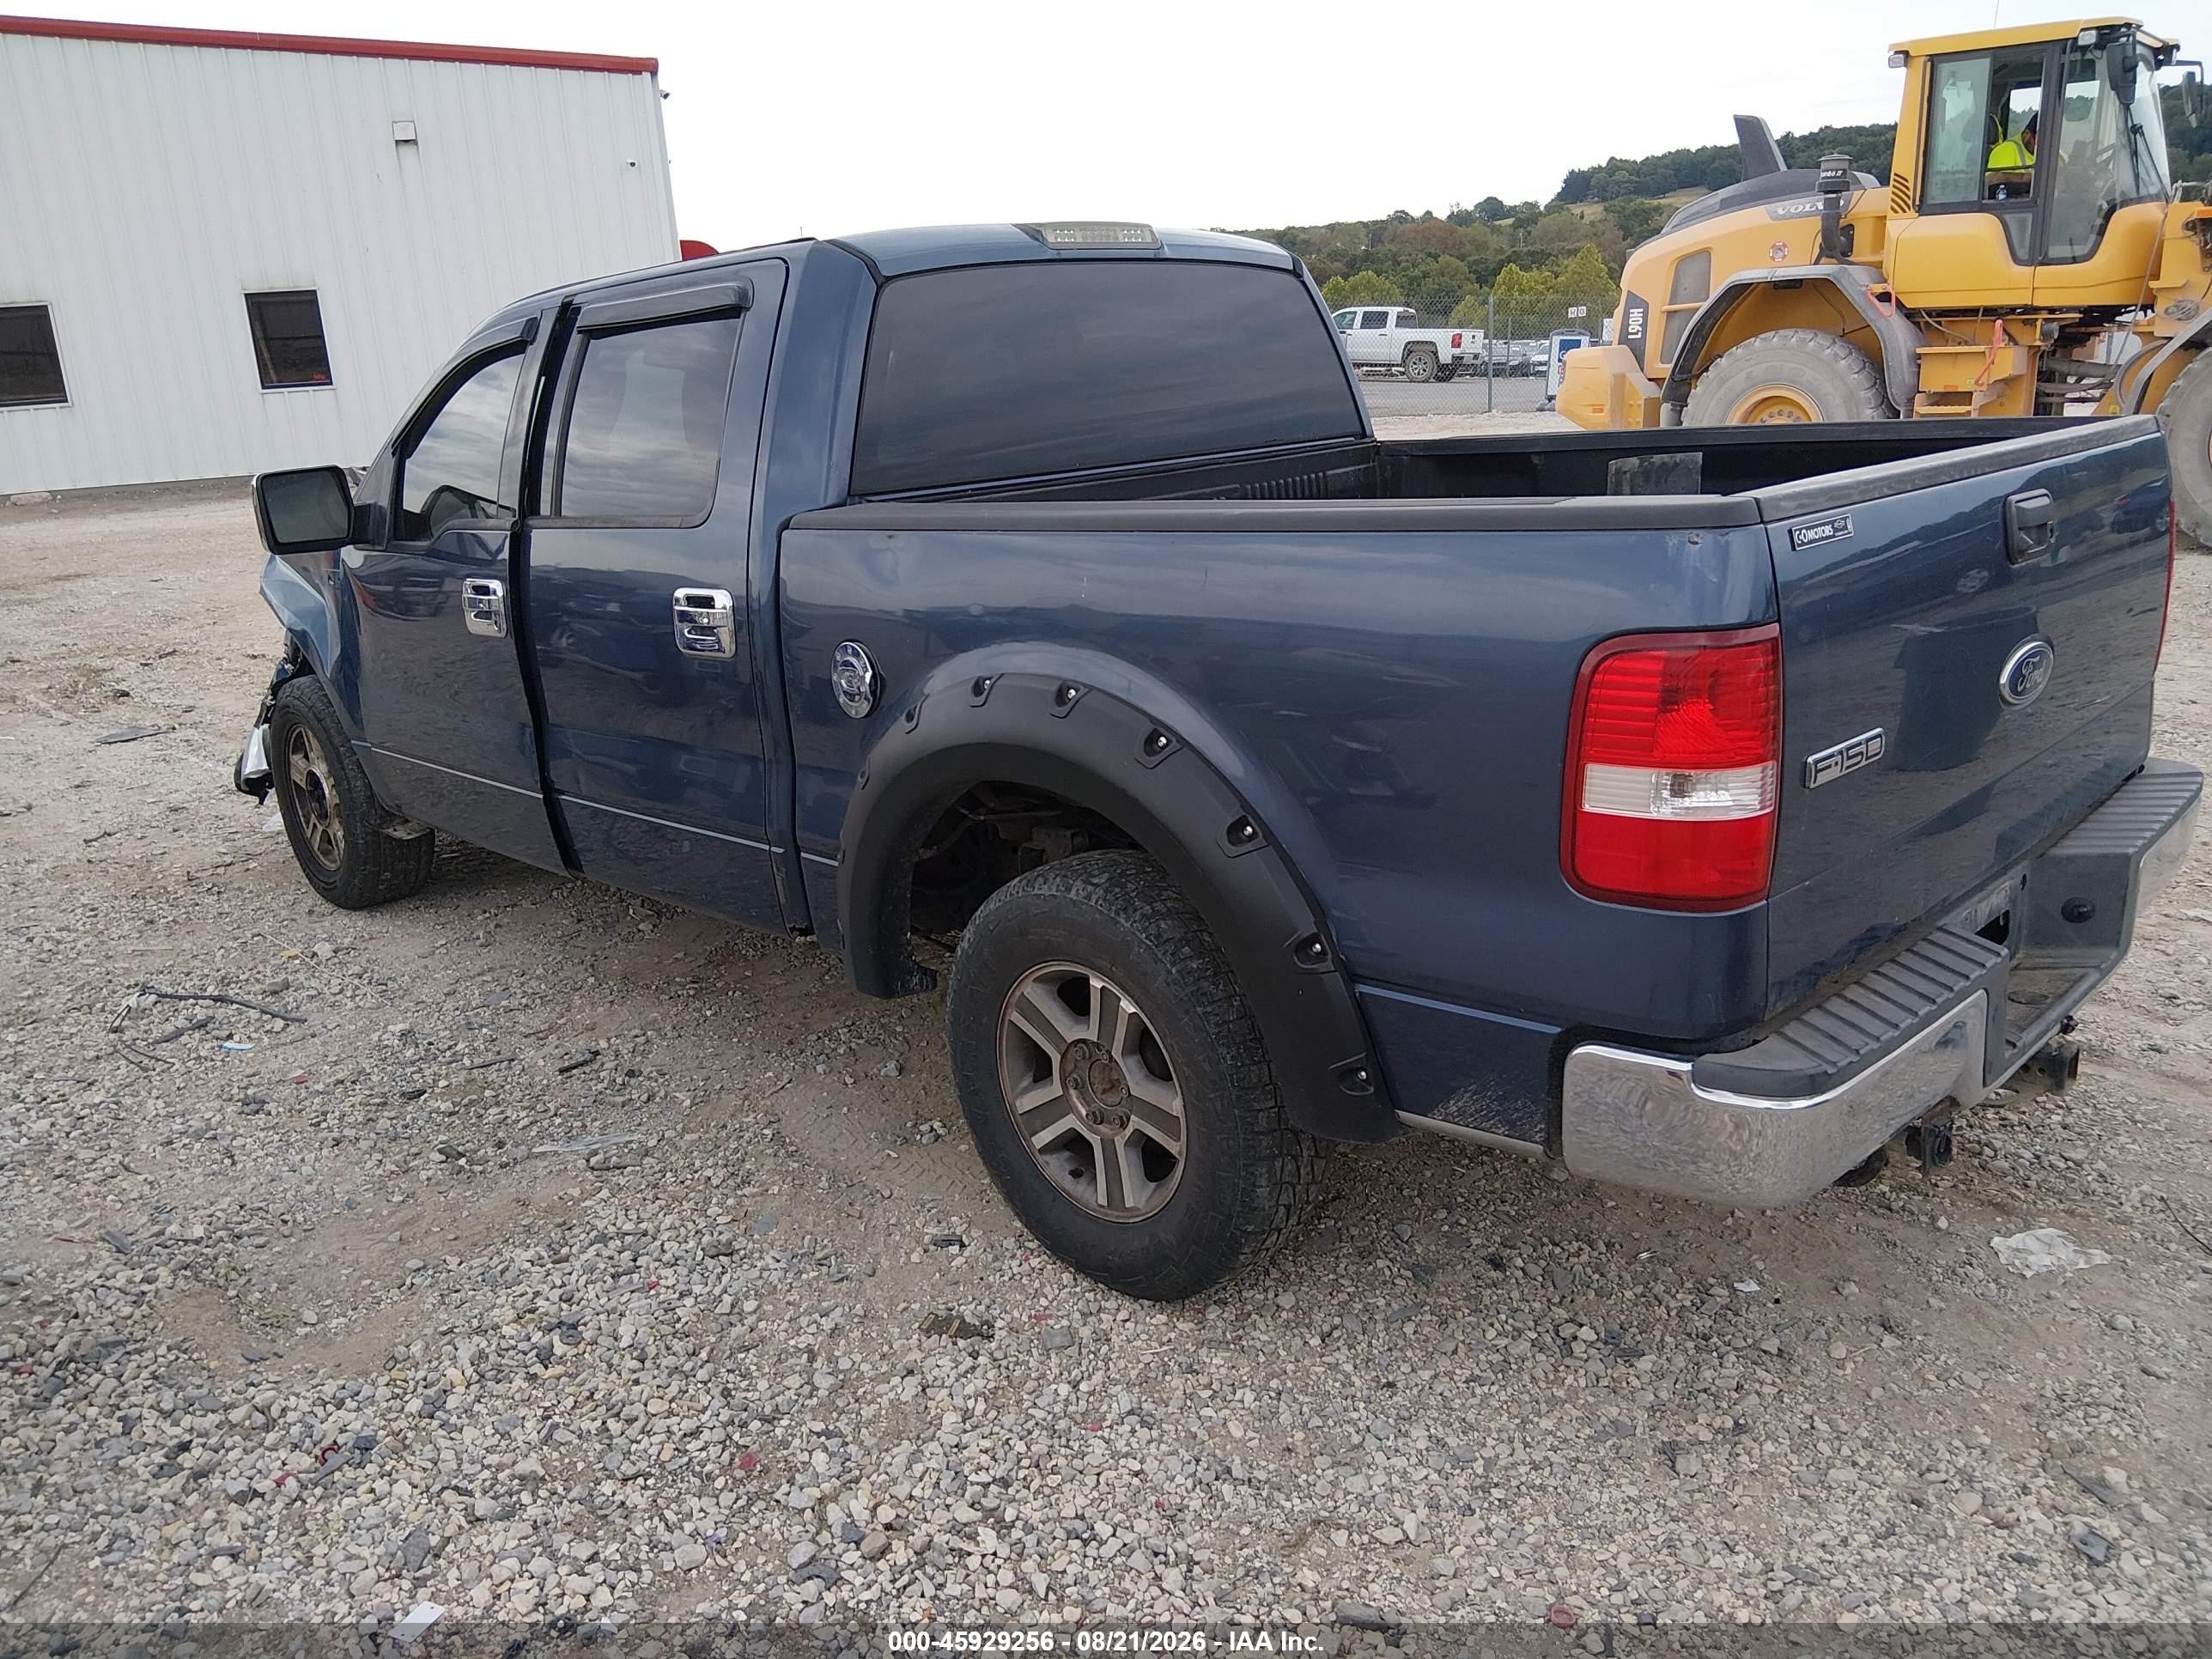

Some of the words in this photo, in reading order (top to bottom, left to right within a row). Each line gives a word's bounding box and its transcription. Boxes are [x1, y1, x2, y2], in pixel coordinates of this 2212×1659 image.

[1777, 199, 1844, 215] VOLV
[1627, 307, 1644, 340] L90H
[2017, 654, 2047, 693] Ford
